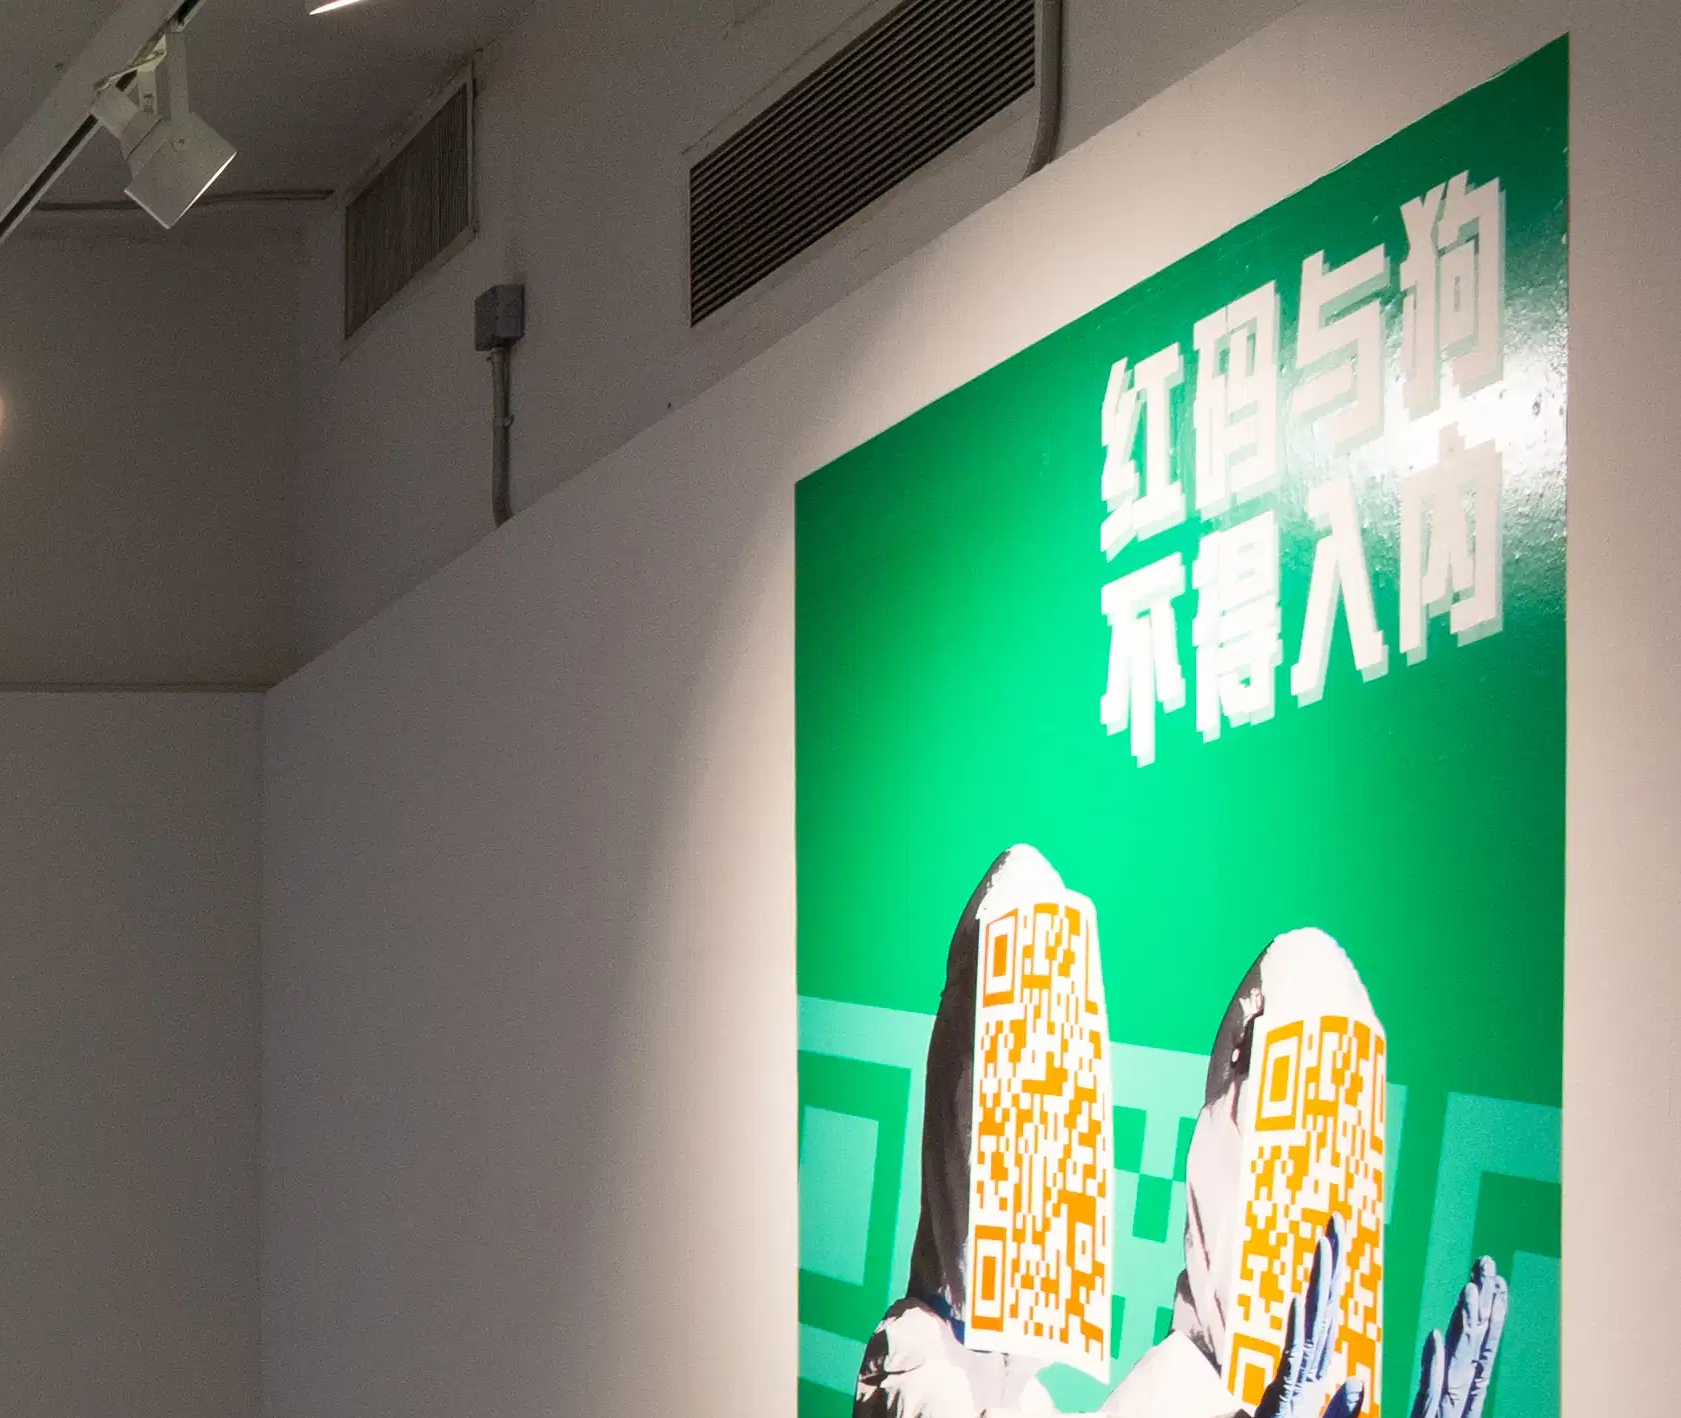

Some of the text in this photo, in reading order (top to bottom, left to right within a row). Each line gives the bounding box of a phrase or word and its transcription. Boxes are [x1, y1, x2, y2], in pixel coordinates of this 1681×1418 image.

[1100, 171, 1506, 560] 红码与狗
[1100, 421, 1504, 767] 不得入内
